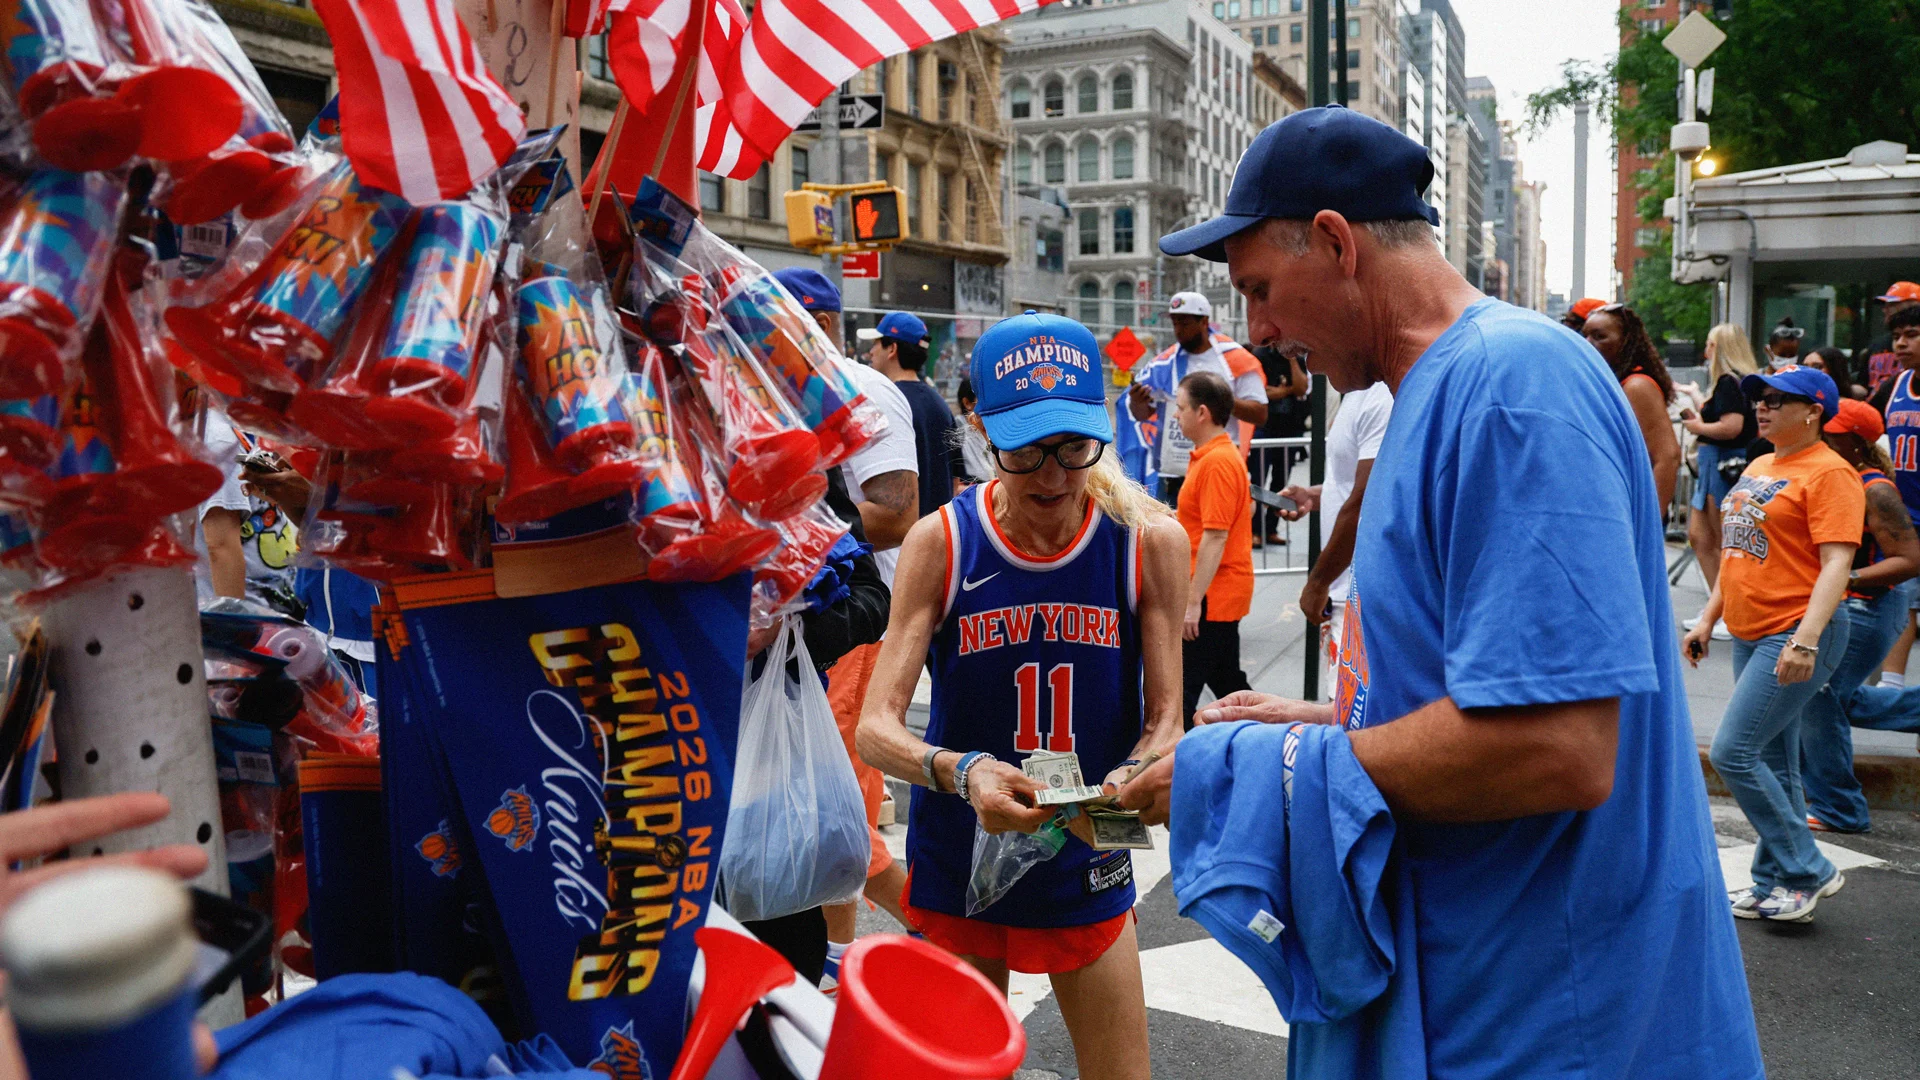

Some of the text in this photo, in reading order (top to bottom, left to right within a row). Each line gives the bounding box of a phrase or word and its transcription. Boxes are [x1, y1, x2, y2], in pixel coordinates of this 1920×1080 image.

[995, 344, 1090, 380] CHAMPIONS
[1029, 336, 1056, 345] NBA
[1015, 374, 1077, 391] 20 26
[1031, 366, 1063, 381] KNICKS
[1894, 434, 1918, 472] 11
[959, 602, 1121, 656] NEW YORK
[1014, 662, 1076, 753] 11
[508, 791, 537, 849] KNICKS
[526, 689, 612, 932] Knicks
[658, 671, 713, 930] 2026 NBA
